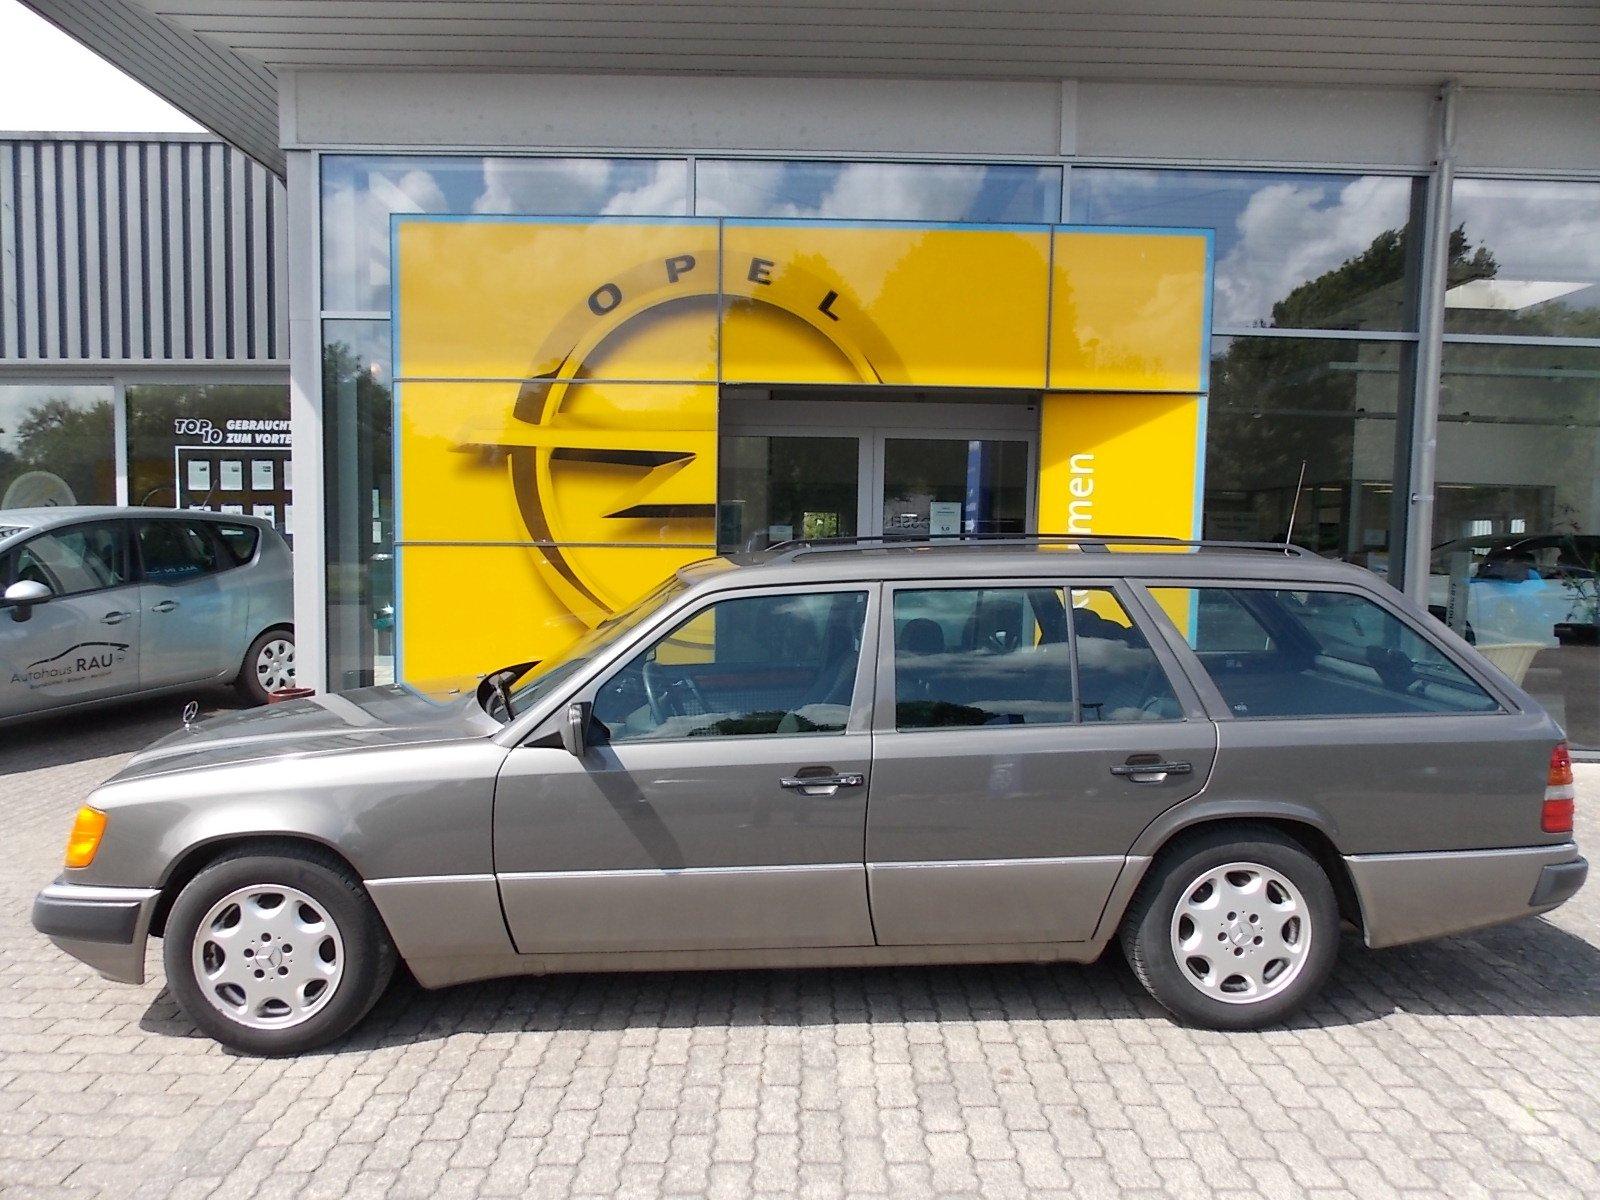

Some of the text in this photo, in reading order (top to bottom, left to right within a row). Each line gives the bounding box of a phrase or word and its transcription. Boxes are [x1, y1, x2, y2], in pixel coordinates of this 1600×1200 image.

[588, 254, 841, 322] OPEL
[174, 418, 212, 435] TOP
[202, 428, 223, 444] 10
[225, 433, 251, 444] ZUM
[10, 666, 72, 684] Autohaus
[76, 653, 113, 672] RAU
